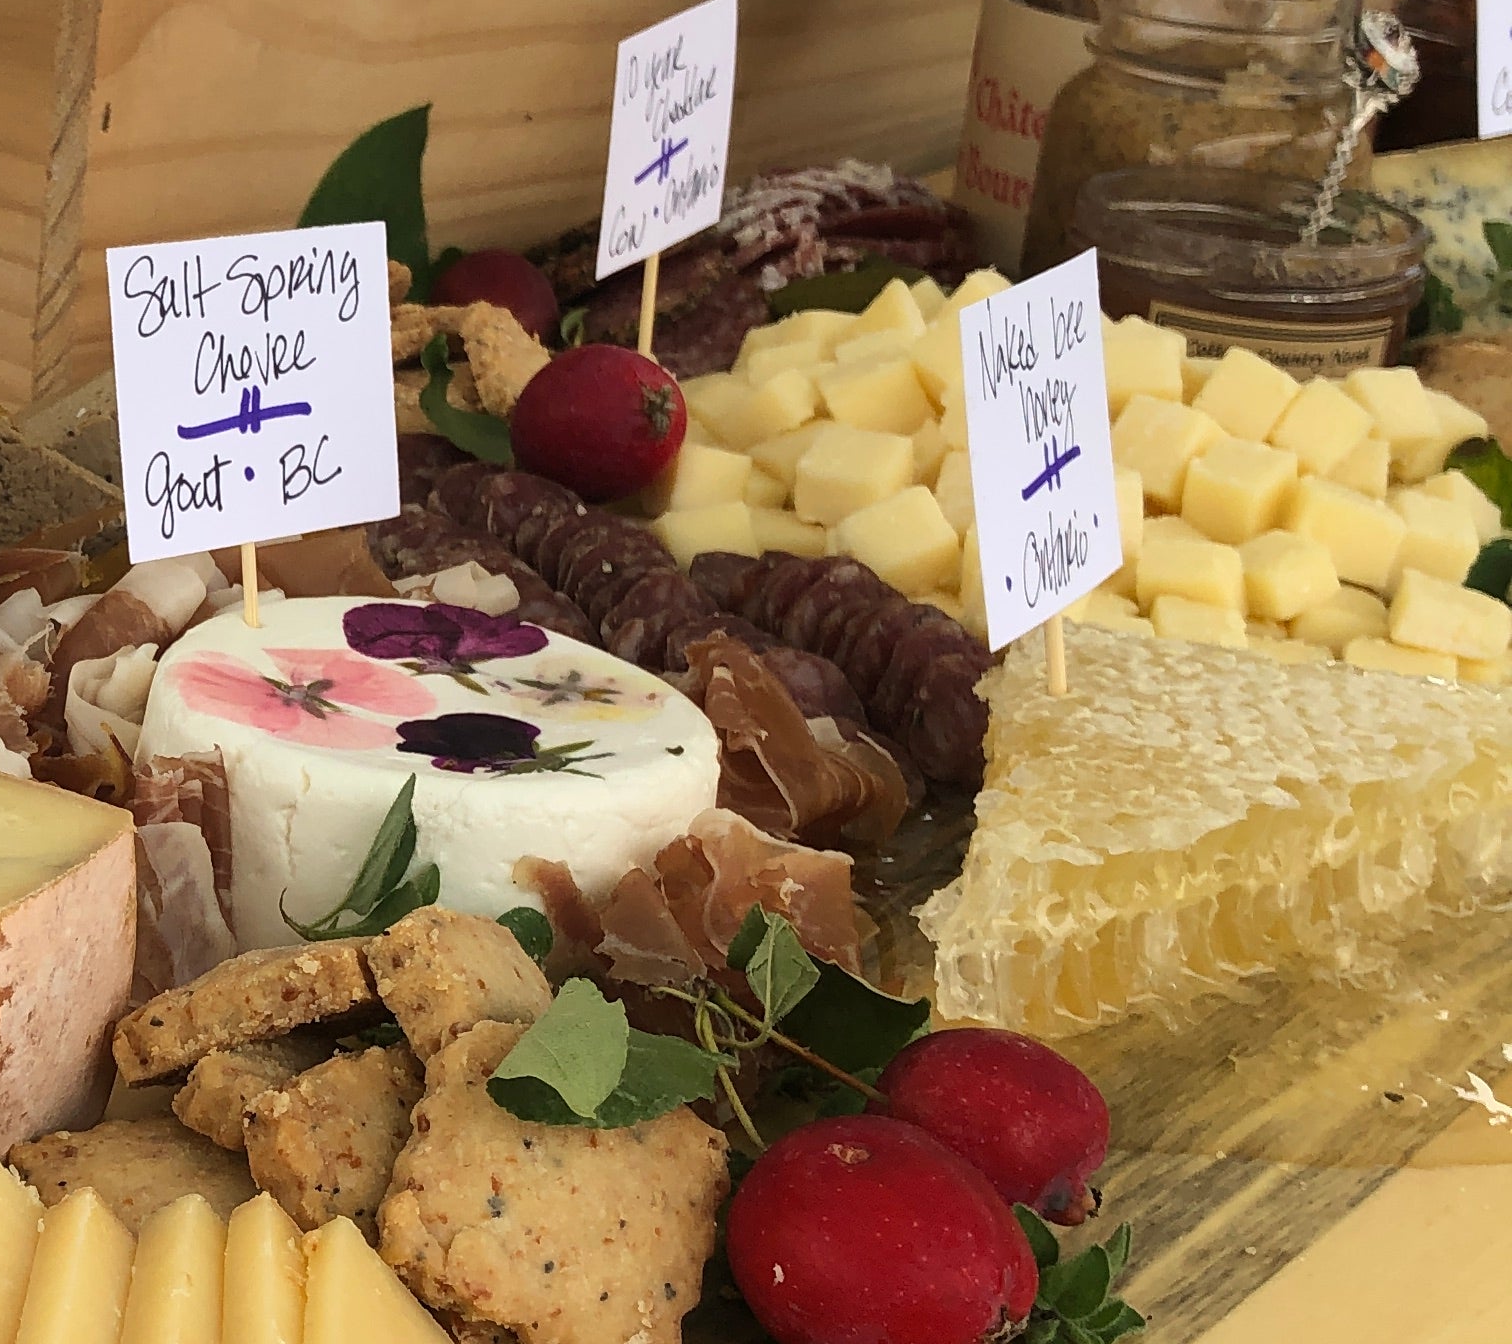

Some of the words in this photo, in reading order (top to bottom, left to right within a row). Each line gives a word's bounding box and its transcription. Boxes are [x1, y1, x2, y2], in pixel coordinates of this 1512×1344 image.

[124, 255, 222, 338] Salt
[979, 297, 1040, 401] Naked
[1050, 296, 1086, 360] bee
[279, 435, 343, 506] BC
